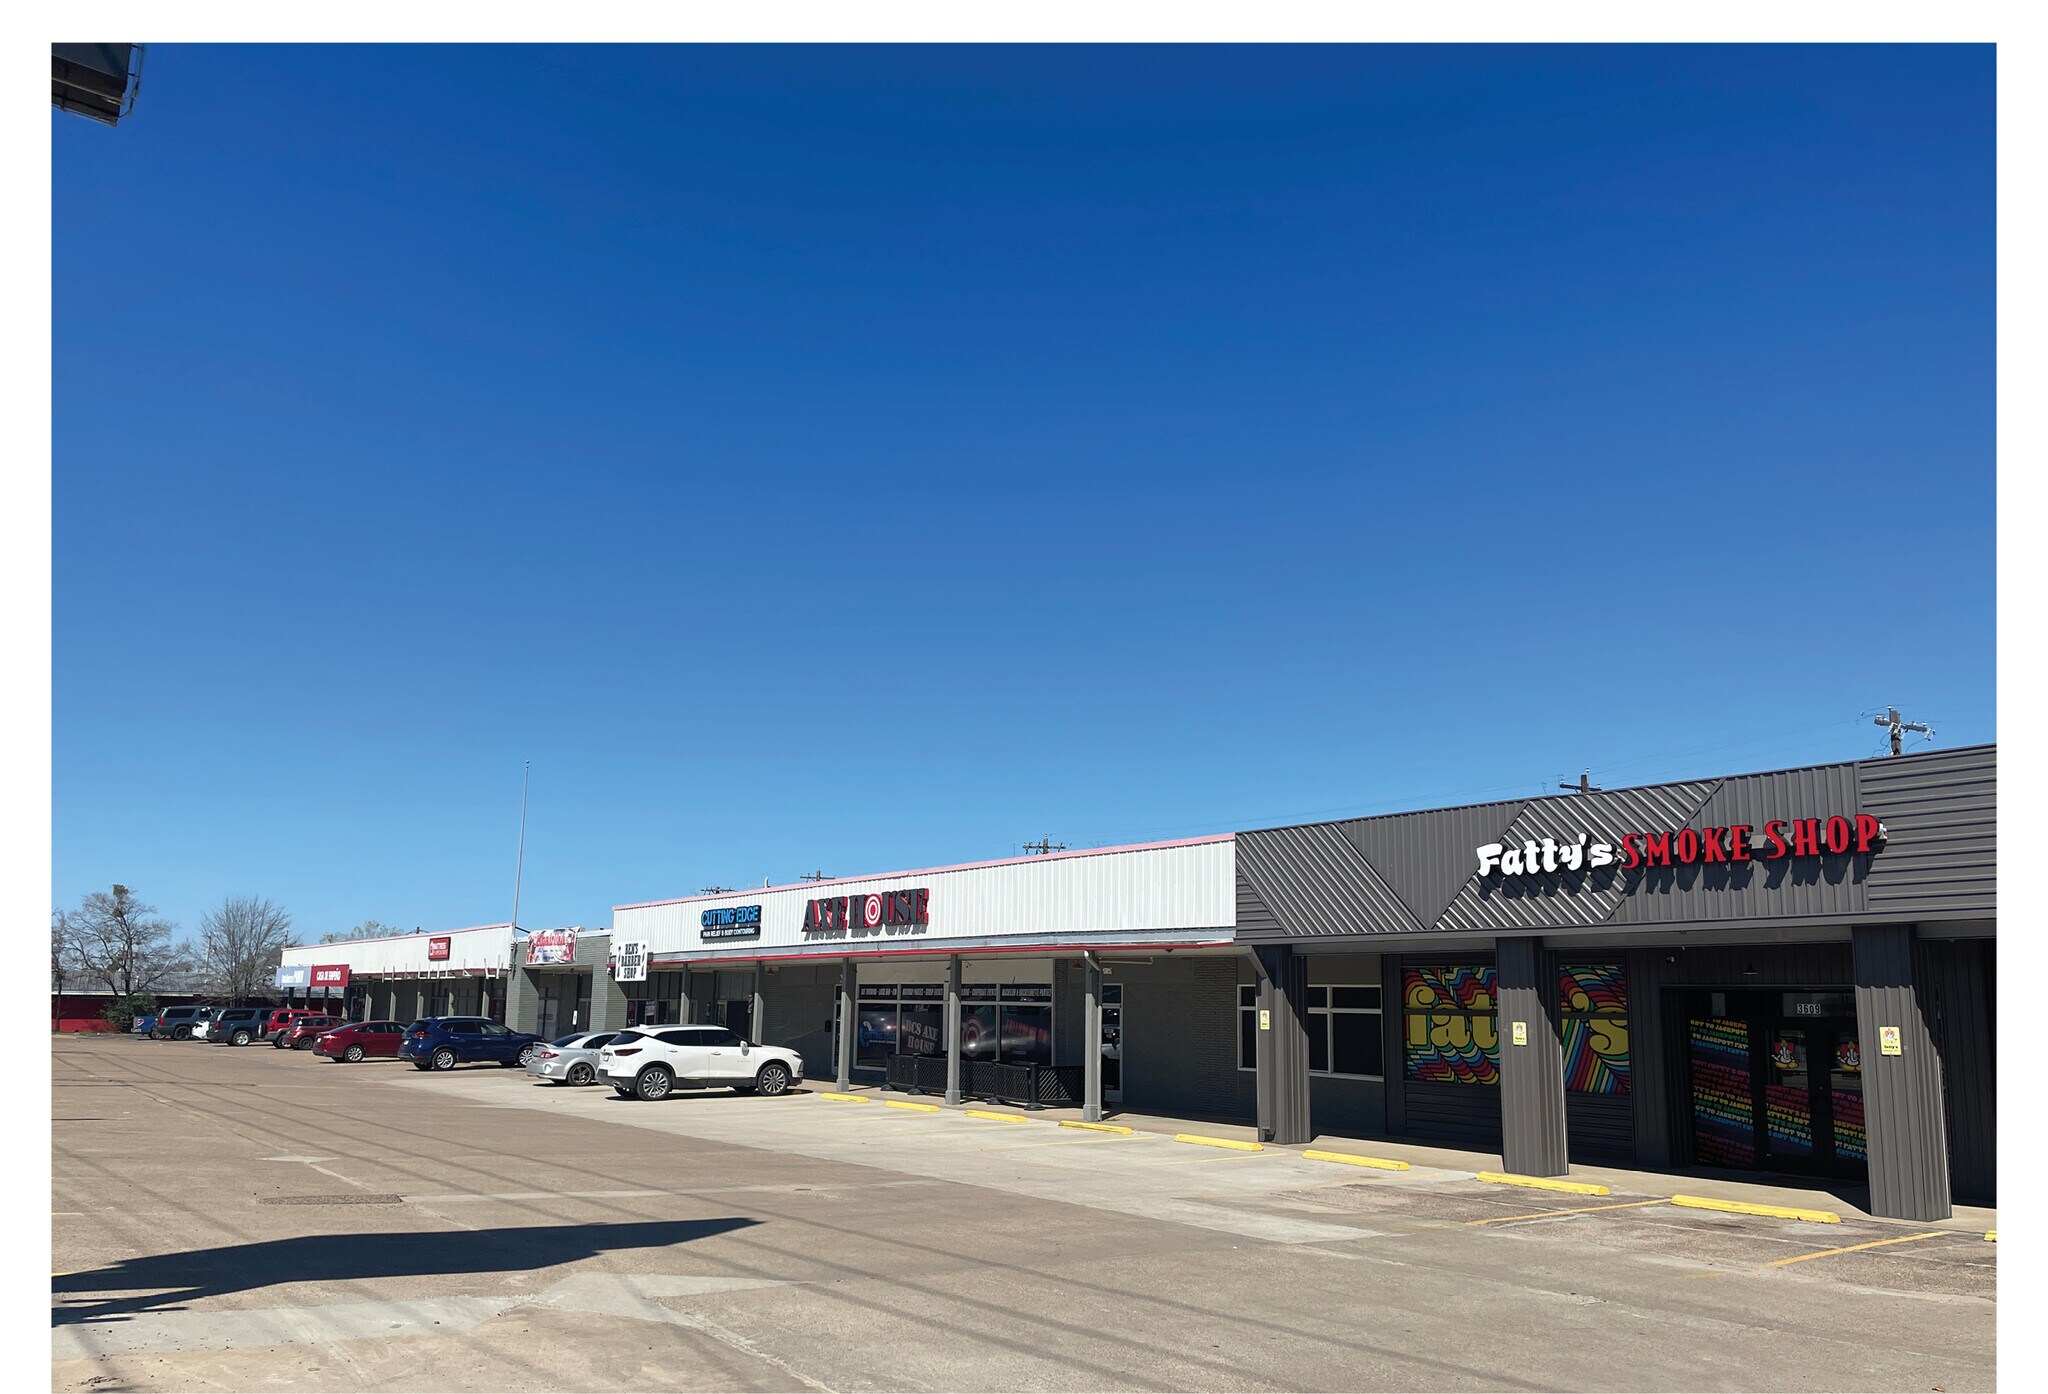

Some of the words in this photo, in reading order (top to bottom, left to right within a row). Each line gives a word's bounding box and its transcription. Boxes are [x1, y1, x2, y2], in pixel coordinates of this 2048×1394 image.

[1476, 832, 1617, 878] Fatty's
[1622, 824, 1753, 870] SMOKE
[1764, 814, 1879, 860] SHOP
[701, 908, 735, 926] CUTTING
[736, 906, 759, 923] EDGE
[801, 896, 848, 932] AXE
[848, 888, 930, 930] HOUSE
[621, 954, 641, 967] BARBER
[623, 967, 637, 980] SHOP
[1798, 1004, 1820, 1014] 3609
[922, 1025, 939, 1041] AXE
